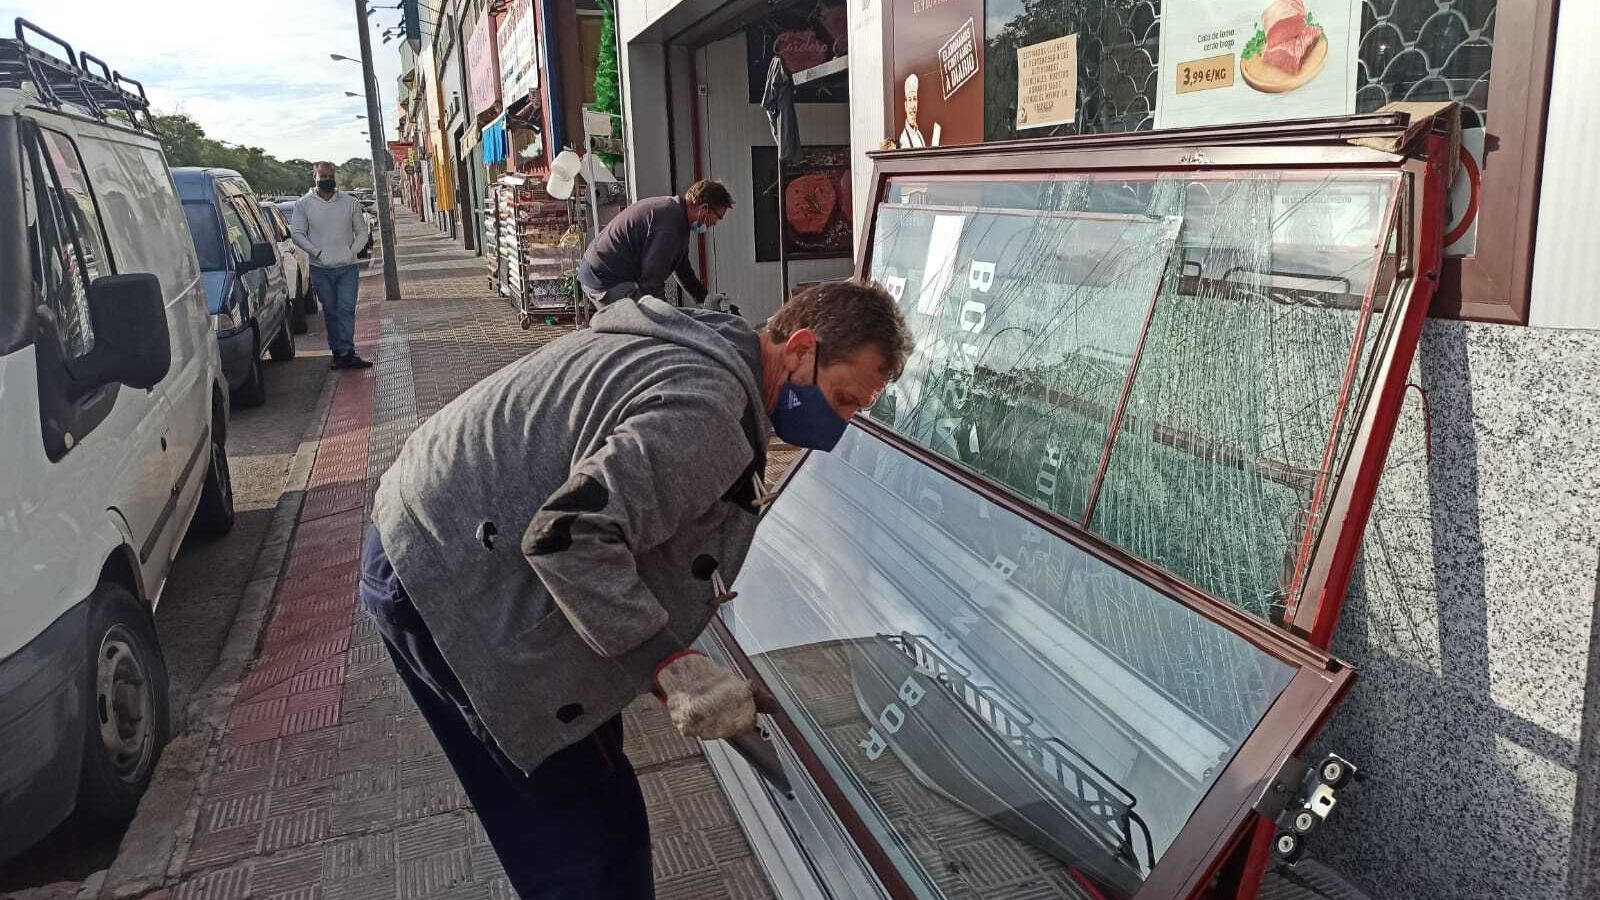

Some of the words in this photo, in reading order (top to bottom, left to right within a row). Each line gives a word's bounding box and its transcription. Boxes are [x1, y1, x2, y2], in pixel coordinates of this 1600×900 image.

[1212, 31, 1219, 40] de
[1219, 29, 1235, 38] lomo
[947, 40, 973, 72] CORTAMOS
[951, 53, 975, 88] DIARIO
[1183, 67, 1204, 87] 3,99
[1205, 68, 1226, 82] €/KG
